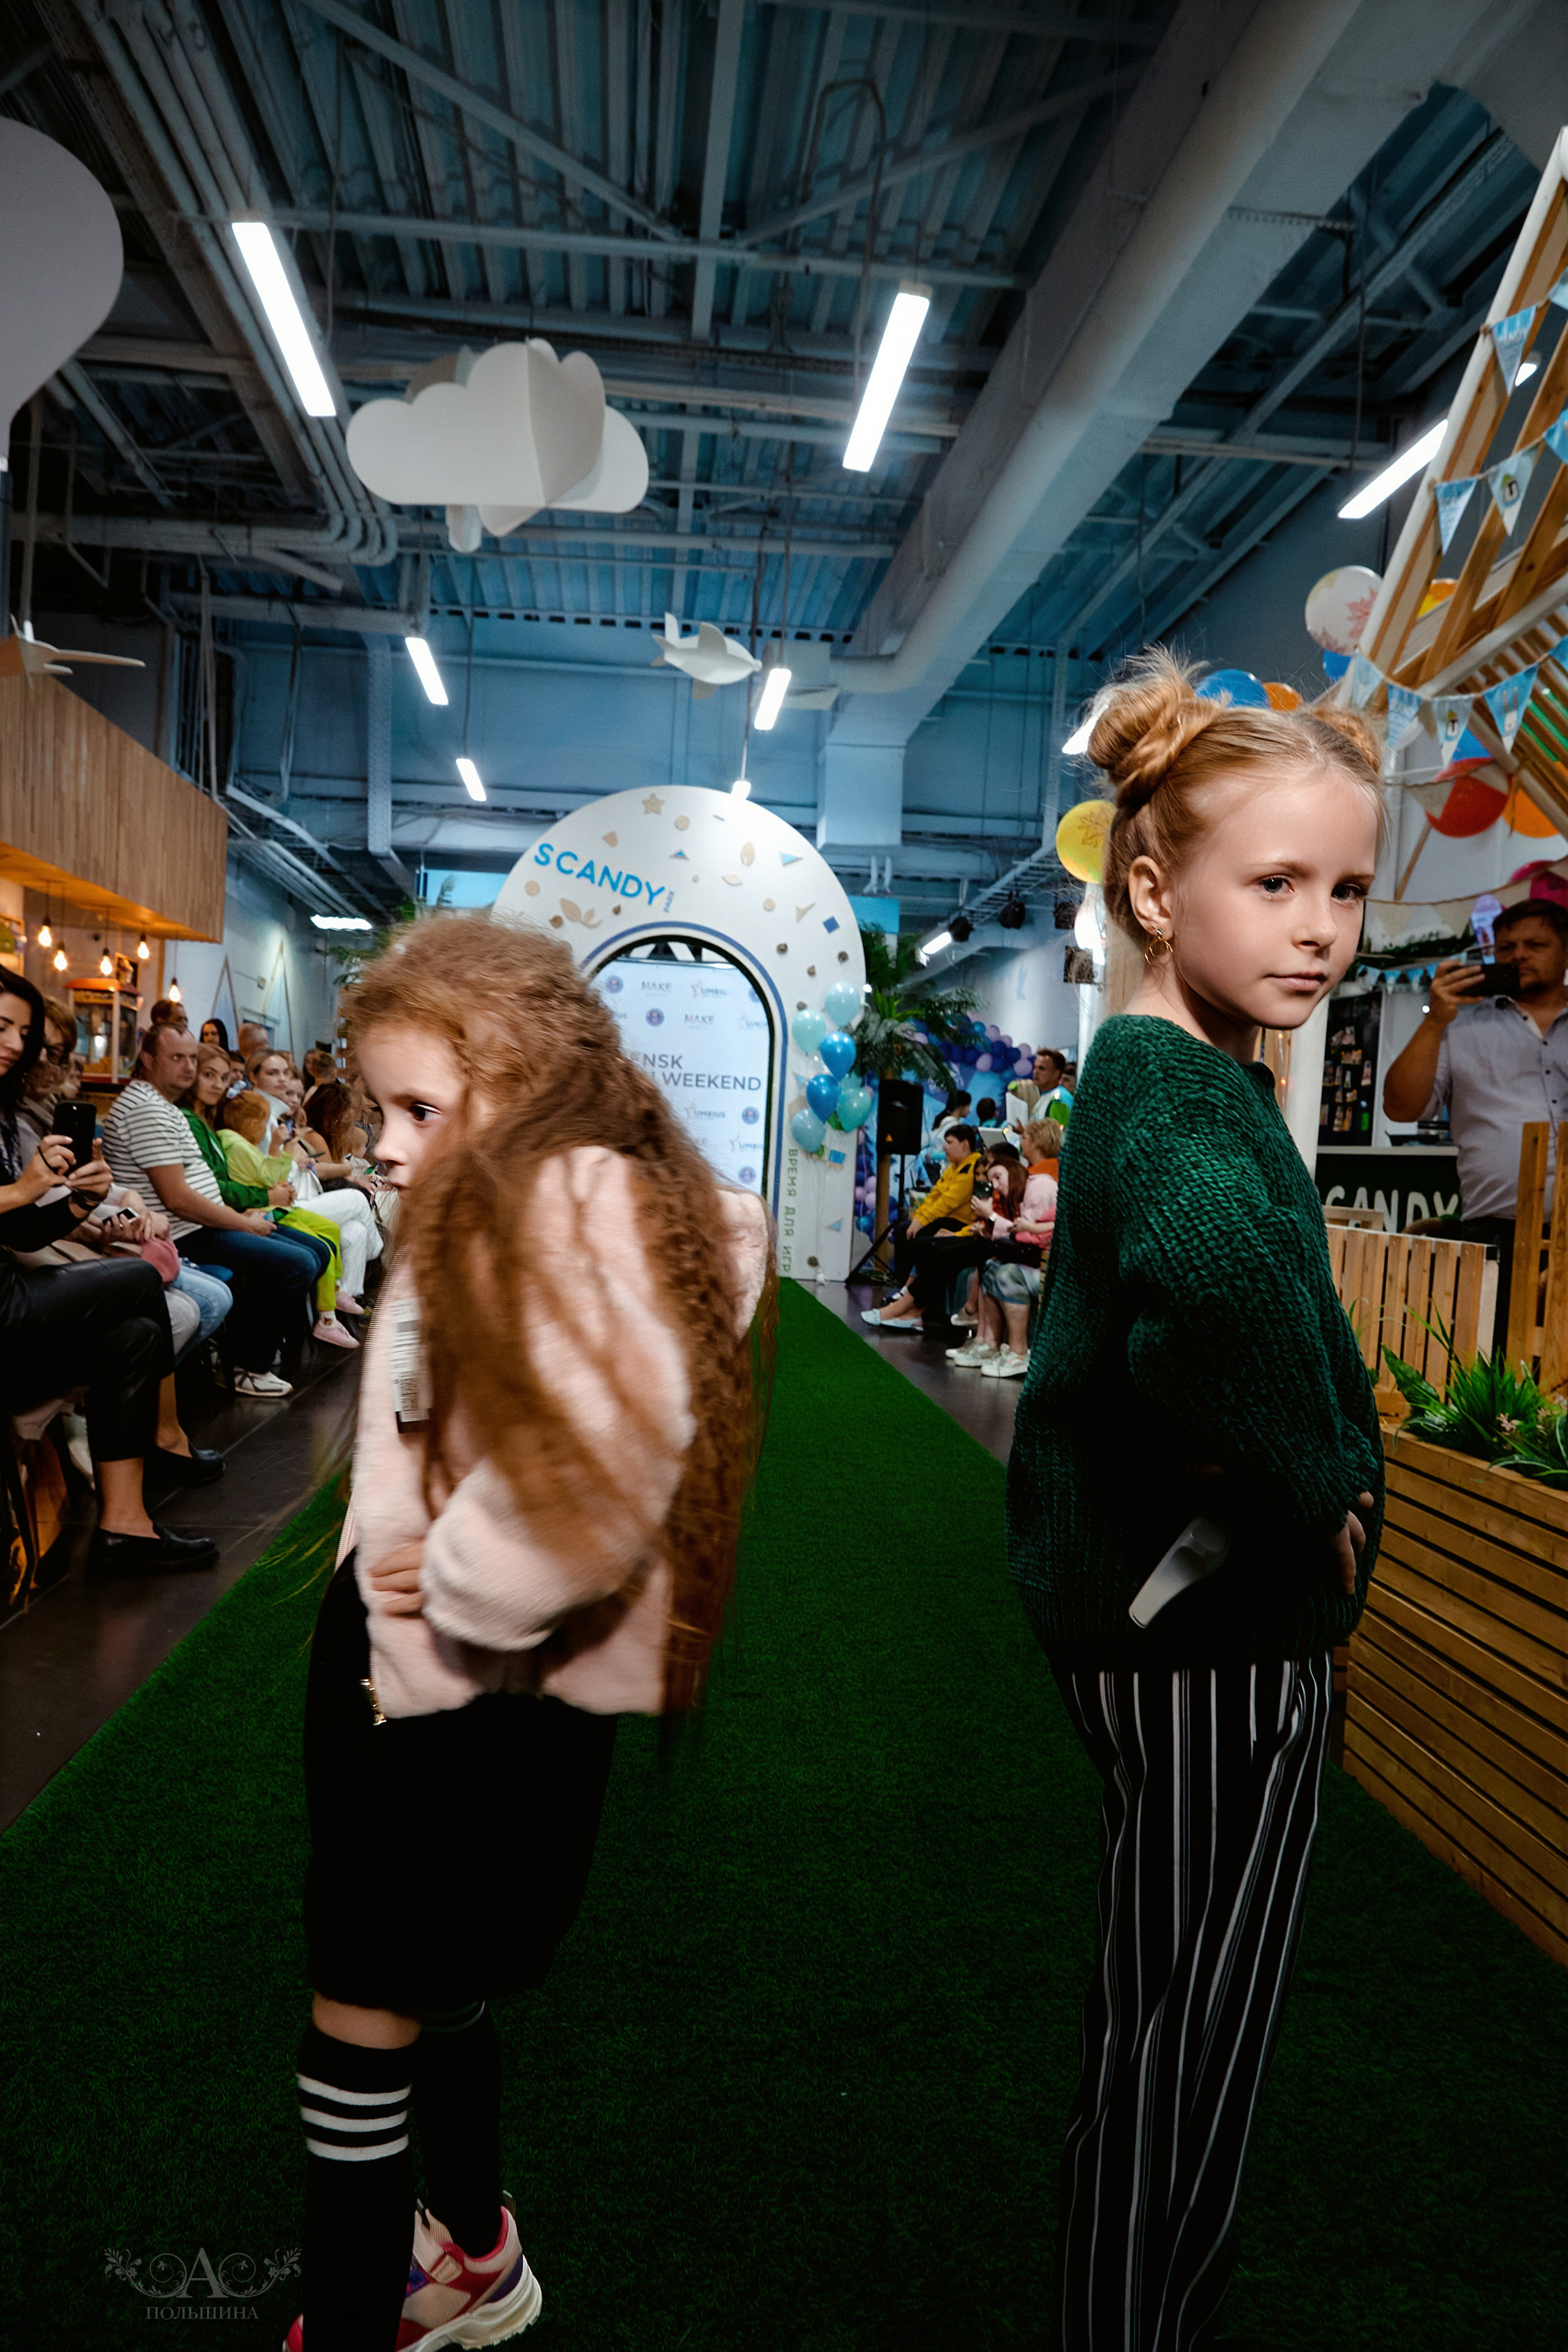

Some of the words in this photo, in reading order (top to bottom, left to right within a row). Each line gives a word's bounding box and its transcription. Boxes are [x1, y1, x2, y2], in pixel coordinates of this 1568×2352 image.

[534, 843, 666, 905] SCANDY
[641, 981, 672, 991] MAKE
[685, 1014, 714, 1023] MAKE
[662, 1072, 761, 1091] WEEKEND
[787, 1148, 798, 1197] ВРЕМЯ
[784, 1205, 796, 1236] ДЛЯ
[782, 1245, 792, 1272] ИГР
